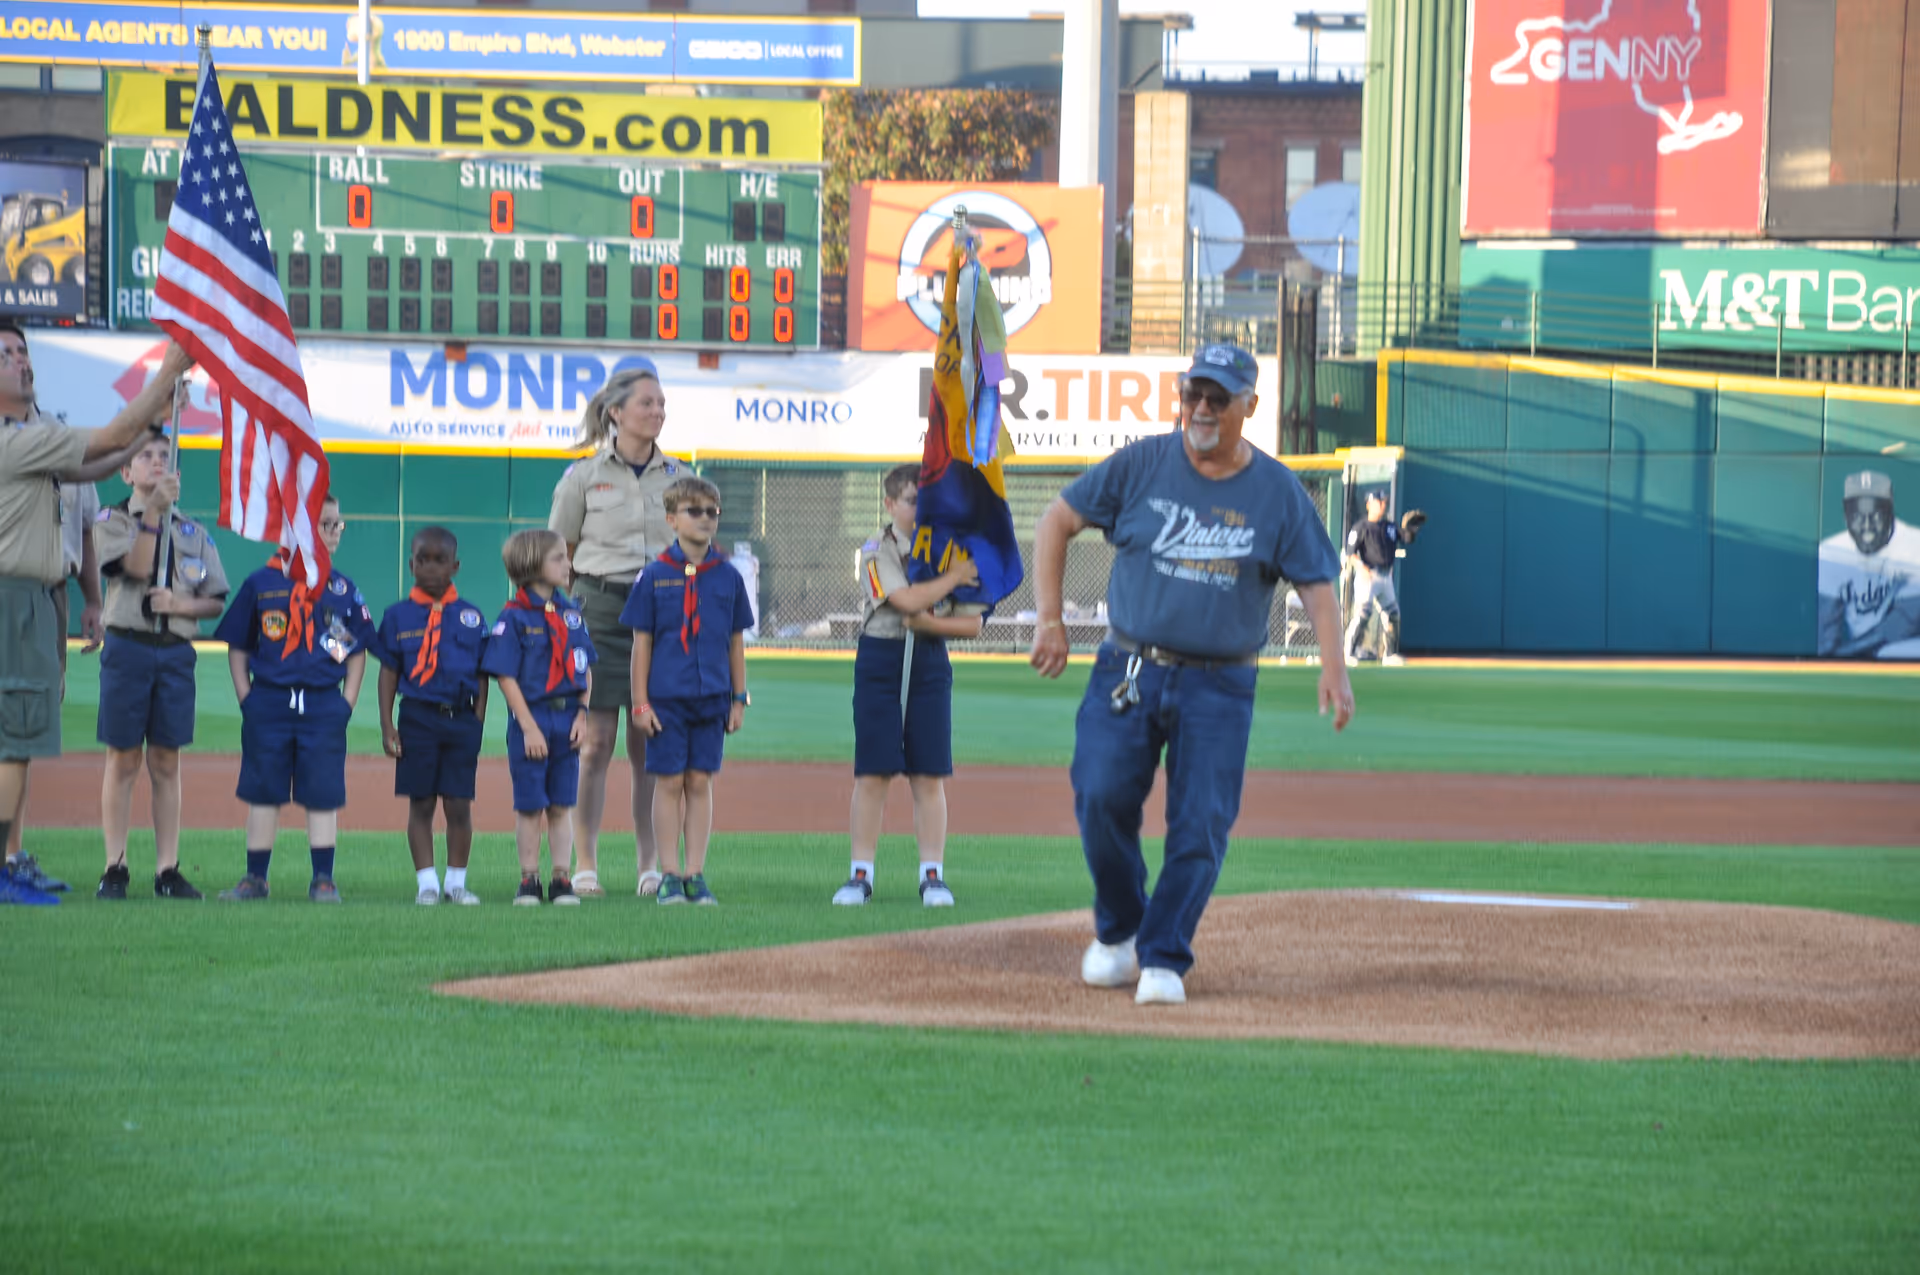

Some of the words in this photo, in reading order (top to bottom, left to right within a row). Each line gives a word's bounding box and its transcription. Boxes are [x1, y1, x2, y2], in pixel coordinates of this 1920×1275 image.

[0, 16, 81, 42] LOCAL
[85, 20, 189, 46] AGENTS
[267, 26, 327, 51] YOU!
[449, 30, 522, 56] Empire
[526, 32, 577, 59] Blvd,
[581, 33, 666, 57] Webster
[1529, 36, 1701, 82] GENNY
[165, 79, 770, 156] BALDNESS.com
[142, 148, 171, 175] AT
[329, 155, 389, 184] BALL
[460, 161, 543, 190] STRIKE
[619, 168, 664, 194] OUT
[740, 172, 778, 200] H/E
[293, 230, 305, 252] 2
[324, 232, 336, 253] 3
[373, 232, 384, 254] 4
[404, 234, 415, 255] 5
[436, 234, 447, 256] 6
[482, 237, 494, 258] 7
[514, 239, 526, 260] 8
[546, 241, 558, 262] 9
[587, 242, 607, 263] 10
[629, 240, 681, 264] RUNS
[705, 244, 747, 267] HITS
[766, 247, 802, 268] ERR
[18, 289, 58, 306] SALES
[1659, 269, 1820, 331] M&T
[736, 397, 852, 424] MONRO
[390, 419, 433, 436] AUTO
[438, 422, 506, 438] SERVICE
[1148, 498, 1255, 555] Vintage
